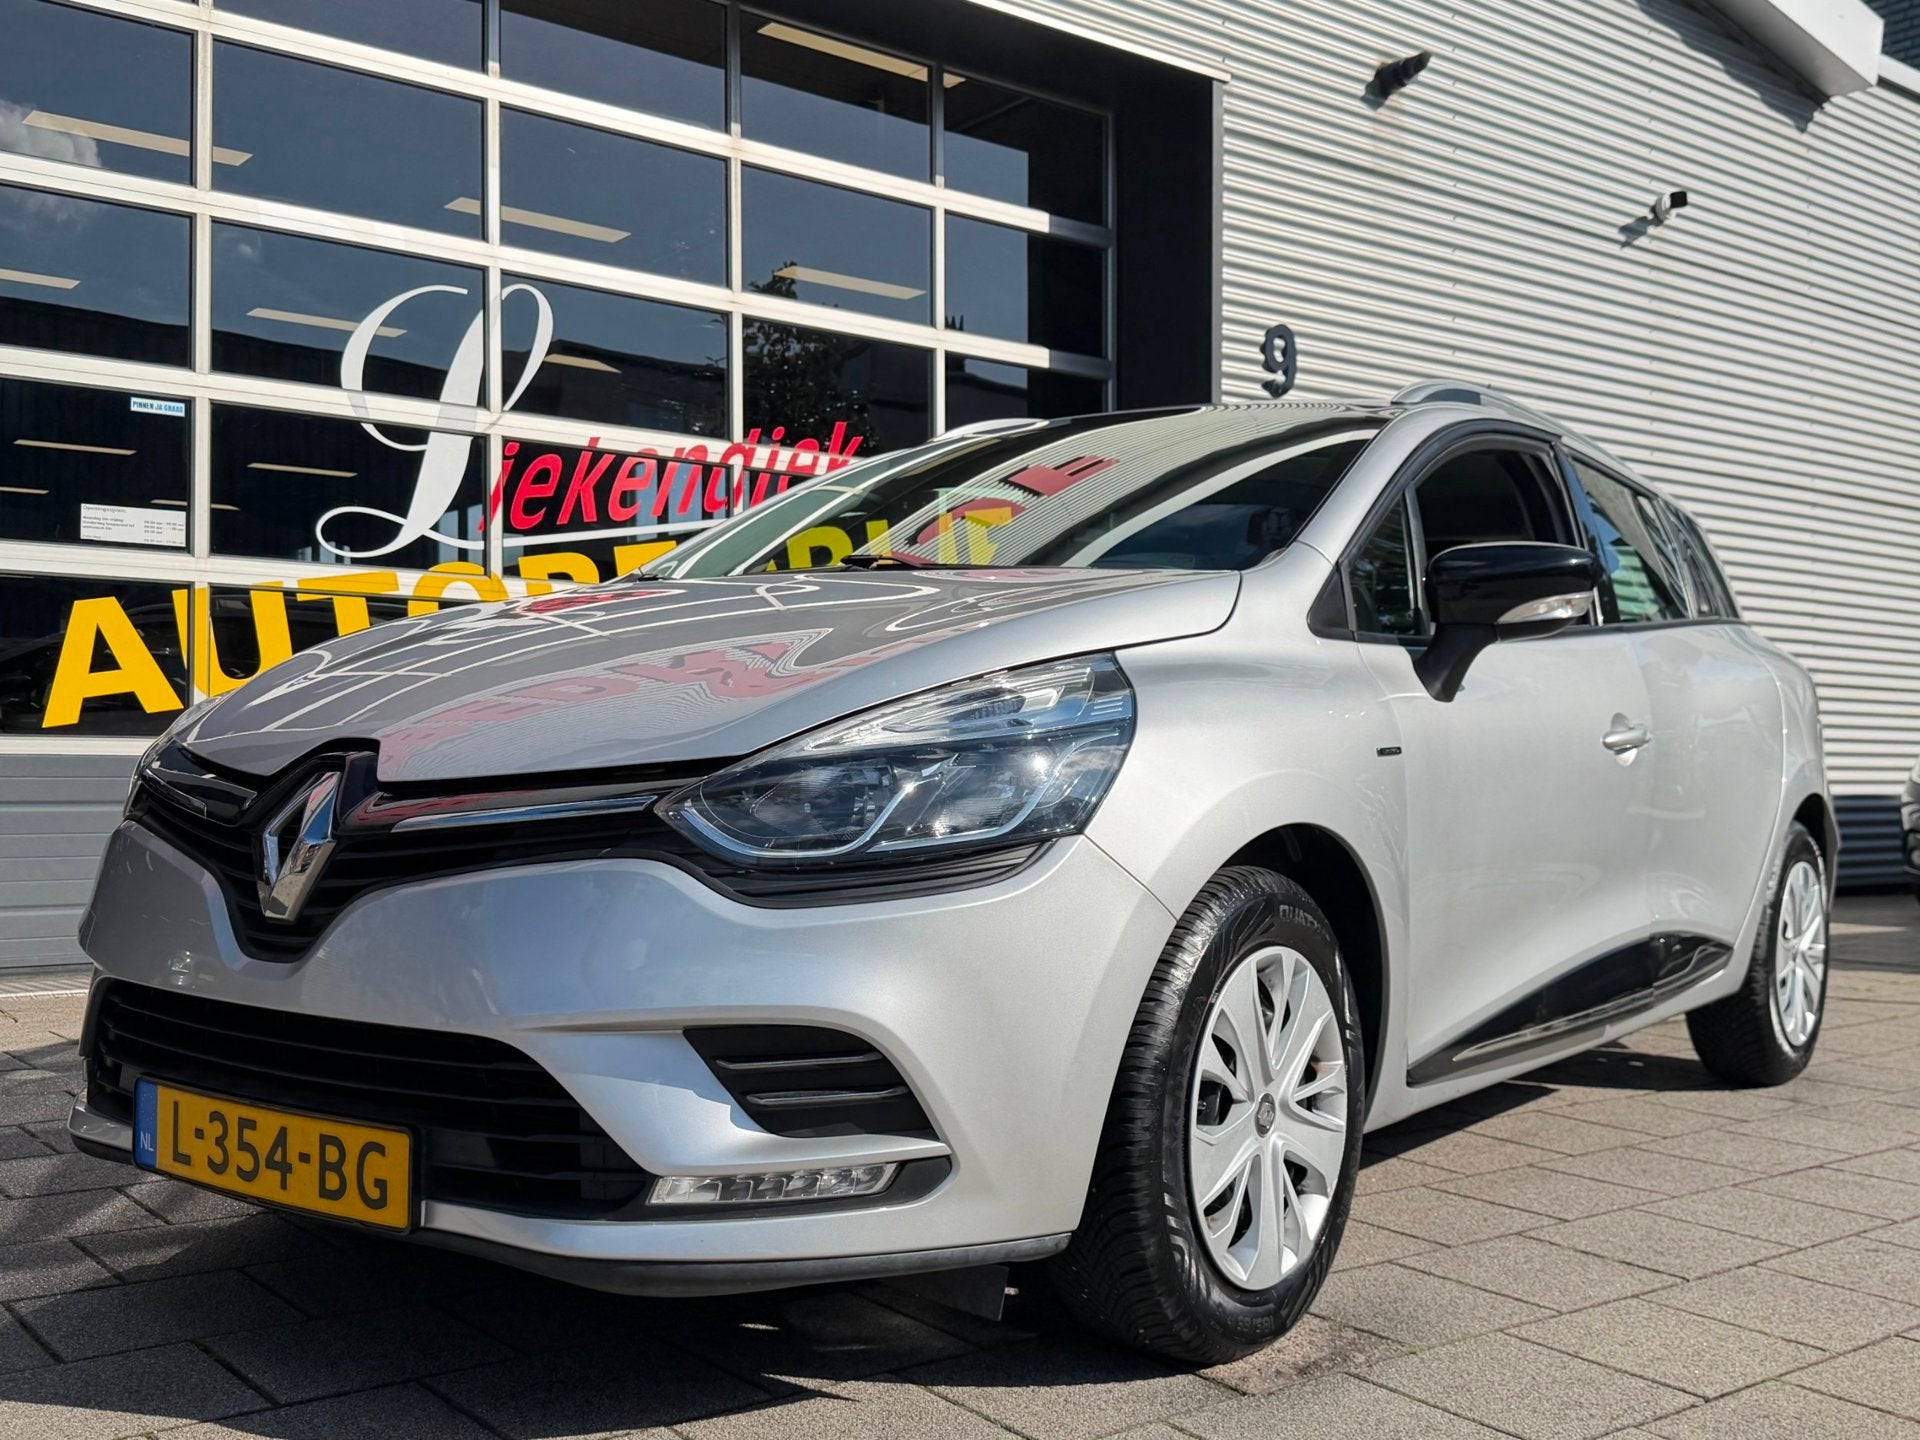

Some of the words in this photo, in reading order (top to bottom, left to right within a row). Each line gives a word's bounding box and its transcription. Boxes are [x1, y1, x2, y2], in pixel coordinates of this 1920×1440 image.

[1261, 324, 1297, 399] 9
[140, 1133, 154, 1152] NL
[172, 1100, 388, 1210] L-354-BG
